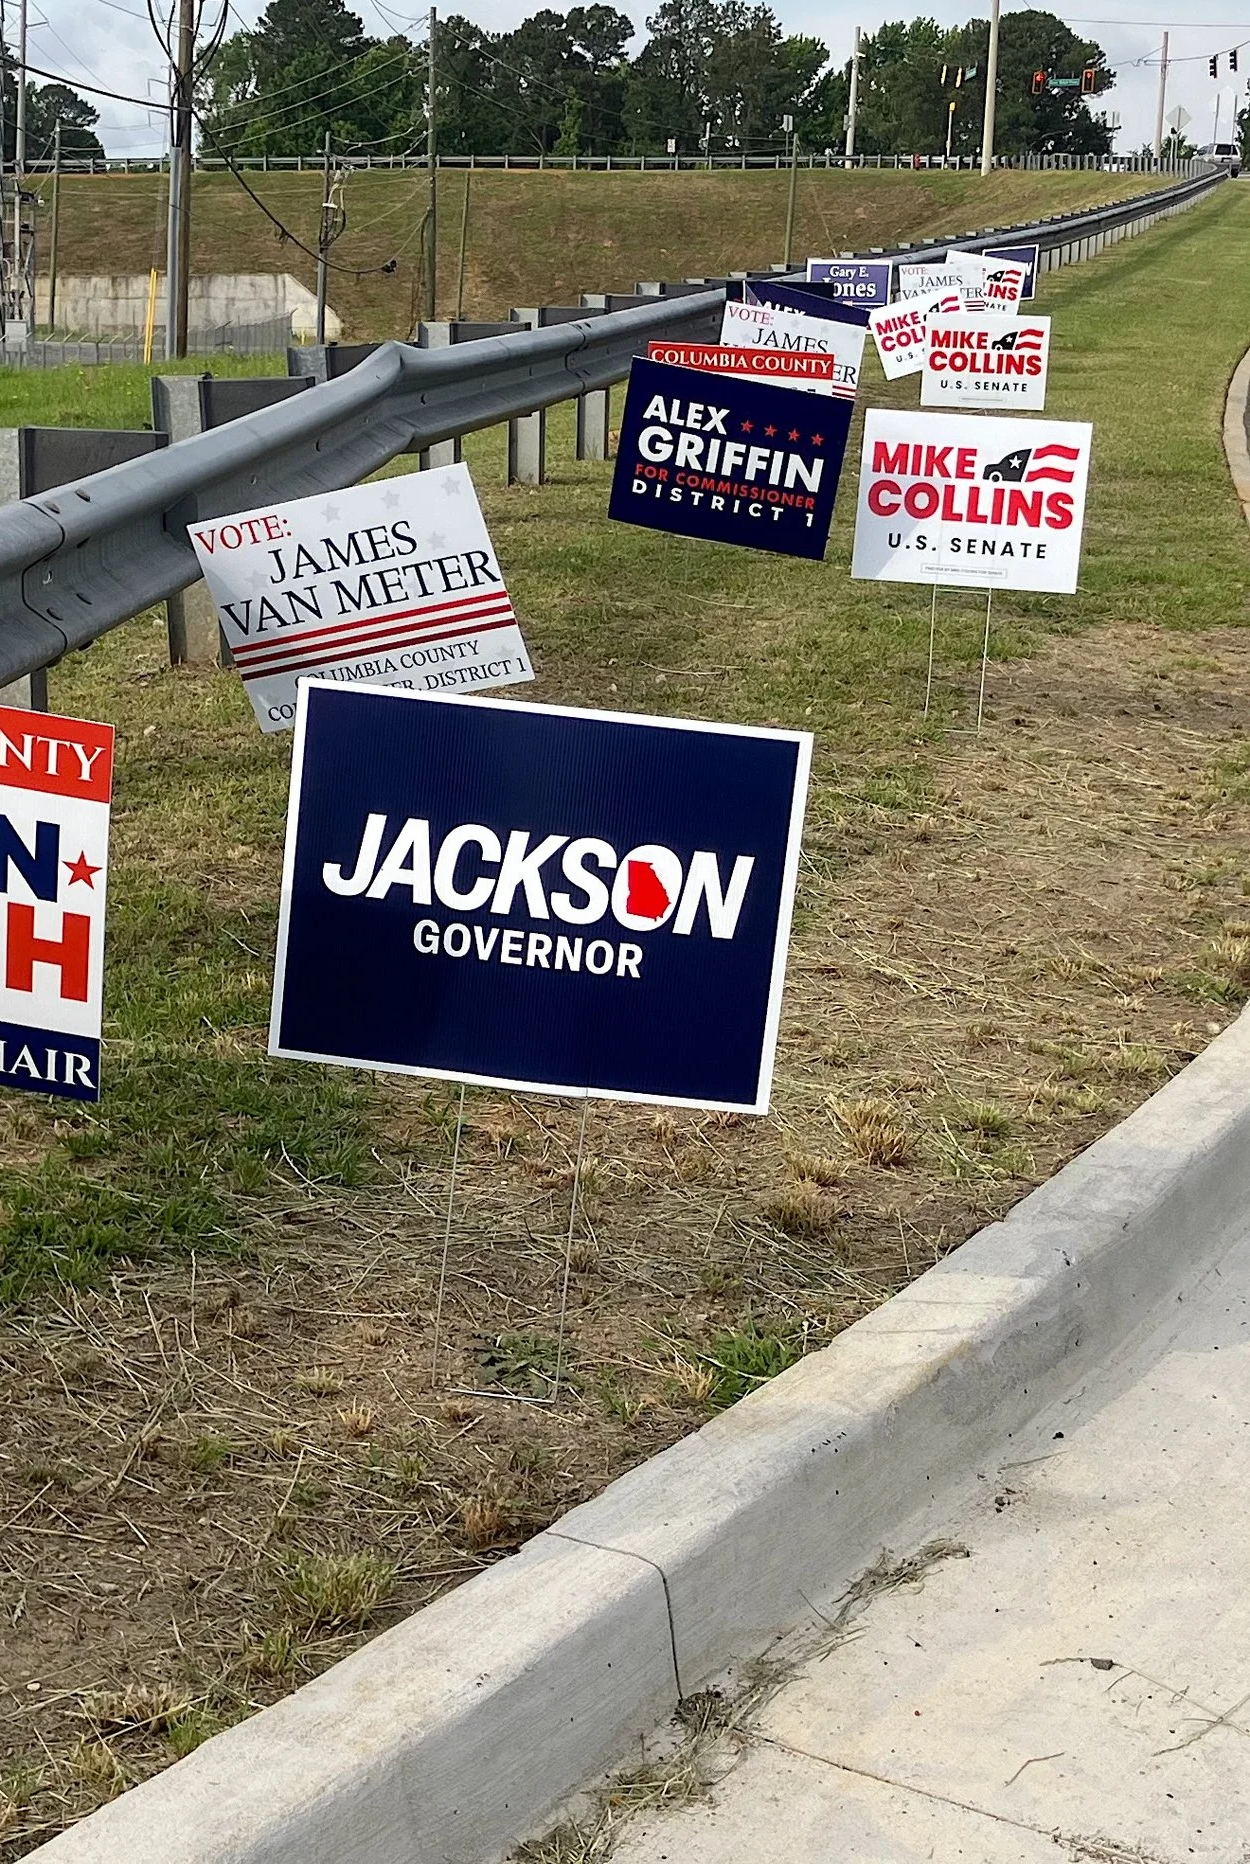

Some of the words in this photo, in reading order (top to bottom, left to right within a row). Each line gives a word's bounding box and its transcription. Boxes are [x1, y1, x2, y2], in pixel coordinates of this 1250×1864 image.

[822, 277, 877, 298] ones
[830, 266, 857, 280] Gary
[859, 266, 869, 278] E.
[919, 275, 963, 287] JAMES
[729, 305, 775, 326] VOTE:
[875, 311, 921, 336] MIKE
[752, 328, 829, 352] JAMES
[931, 330, 989, 350] MIKE
[651, 349, 749, 369] COLUMBIA
[751, 355, 832, 375] COUNTY
[929, 351, 1042, 377] COLLINS
[940, 380, 968, 390] U.S.
[975, 381, 1028, 393] SENATE
[643, 394, 731, 436] ALEX
[638, 425, 825, 494] GRIFFIN
[872, 441, 979, 481] MIKE
[632, 479, 784, 521] DISTRICT
[805, 513, 815, 528] 1
[635, 463, 669, 483] FOR
[675, 472, 816, 511] COMMISSIONER
[867, 479, 1075, 531] COLLINS
[195, 514, 293, 555] VOTE:
[266, 520, 419, 585] JAMES
[888, 532, 938, 552] U.S.
[950, 537, 1048, 560] SENATE
[221, 585, 327, 637] VAN
[334, 549, 501, 617] METER
[294, 657, 398, 689] CLUMBIA
[399, 639, 479, 670] COUNTY
[426, 658, 513, 691] DISTRICT
[517, 656, 528, 673] 1
[322, 812, 756, 940] JACKSON
[412, 918, 644, 979] GOVERNOR
